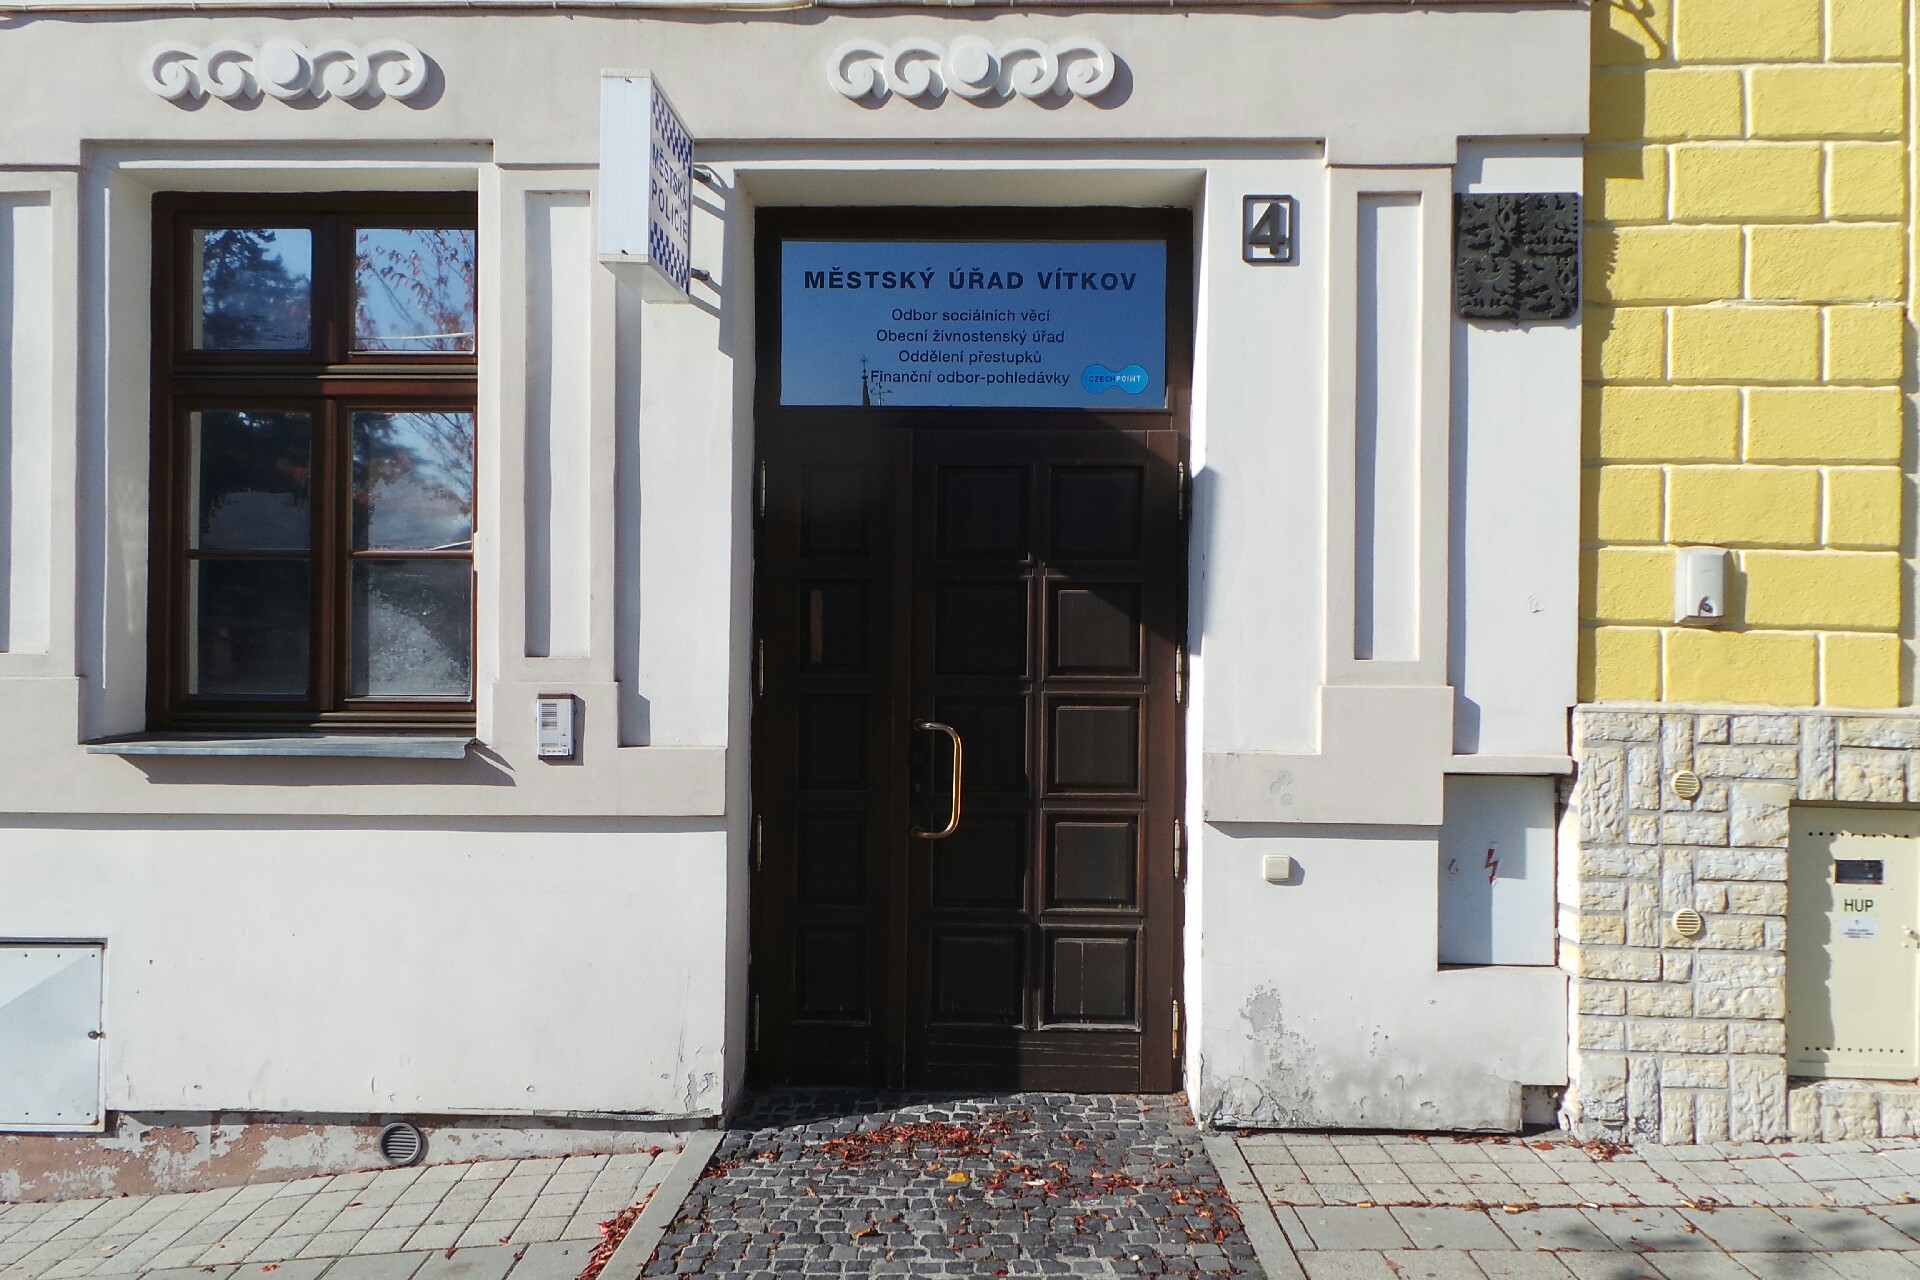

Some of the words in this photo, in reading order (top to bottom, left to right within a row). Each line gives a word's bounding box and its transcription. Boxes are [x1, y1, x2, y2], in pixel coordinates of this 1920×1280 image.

[652, 142, 688, 211] MĚSTSKÁ
[651, 178, 688, 244] POLICIE
[1248, 202, 1286, 255] 4
[804, 267, 935, 290] MĚSTSKÝ
[948, 267, 1024, 290] ÚŘAD
[1037, 268, 1137, 291] VÍTKOV
[891, 307, 938, 322] Odbor
[942, 307, 1016, 322] sociálních
[1019, 308, 1051, 322] věcí
[876, 328, 929, 343] Obecní
[932, 327, 1028, 346] živnostenský
[1032, 328, 1065, 343] úřad
[898, 348, 965, 364] Oddělení
[969, 348, 1042, 365] přestupků
[870, 369, 932, 384] Finanční
[936, 368, 1070, 387] odbor-pohledávky
[1844, 898, 1874, 913] HUP
